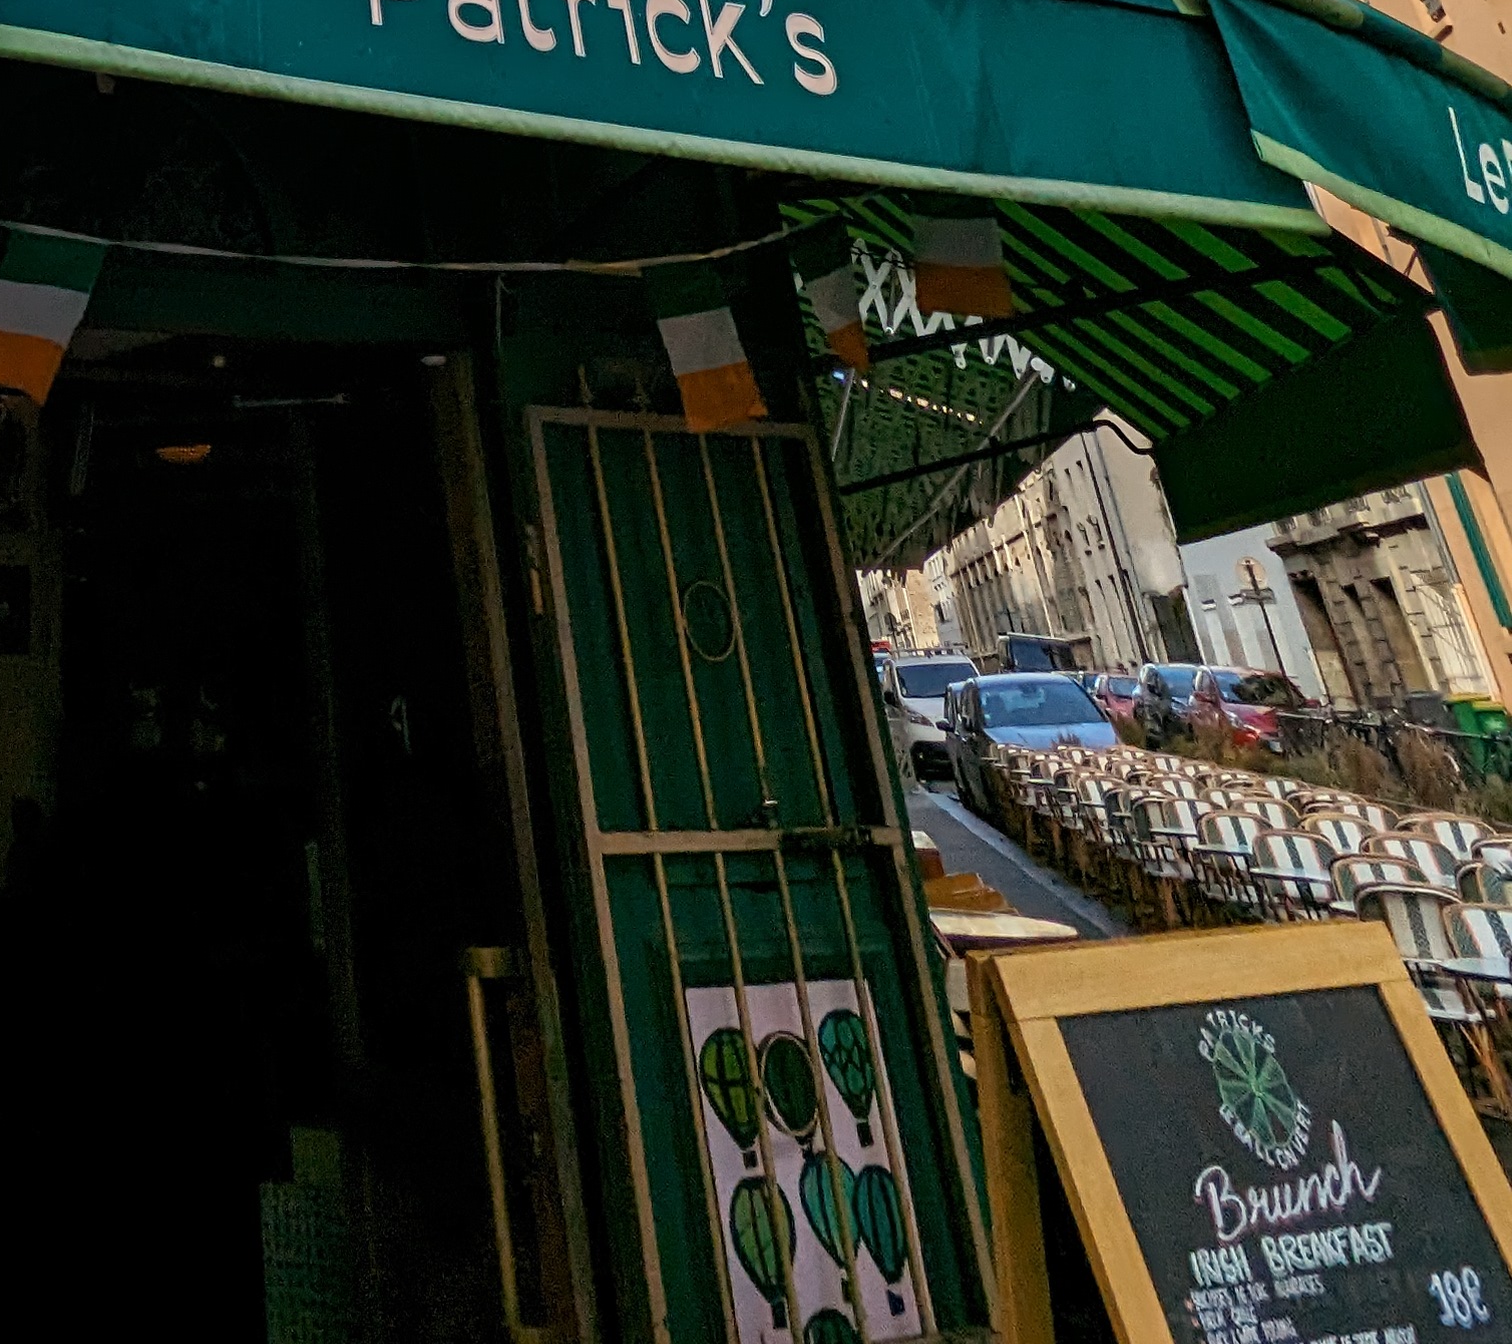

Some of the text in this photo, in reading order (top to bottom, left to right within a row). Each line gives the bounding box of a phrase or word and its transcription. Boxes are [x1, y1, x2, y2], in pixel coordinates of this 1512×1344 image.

[1194, 1118, 1382, 1242] Brunch
[1189, 1221, 1394, 1288] IRISH BREAKFAST
